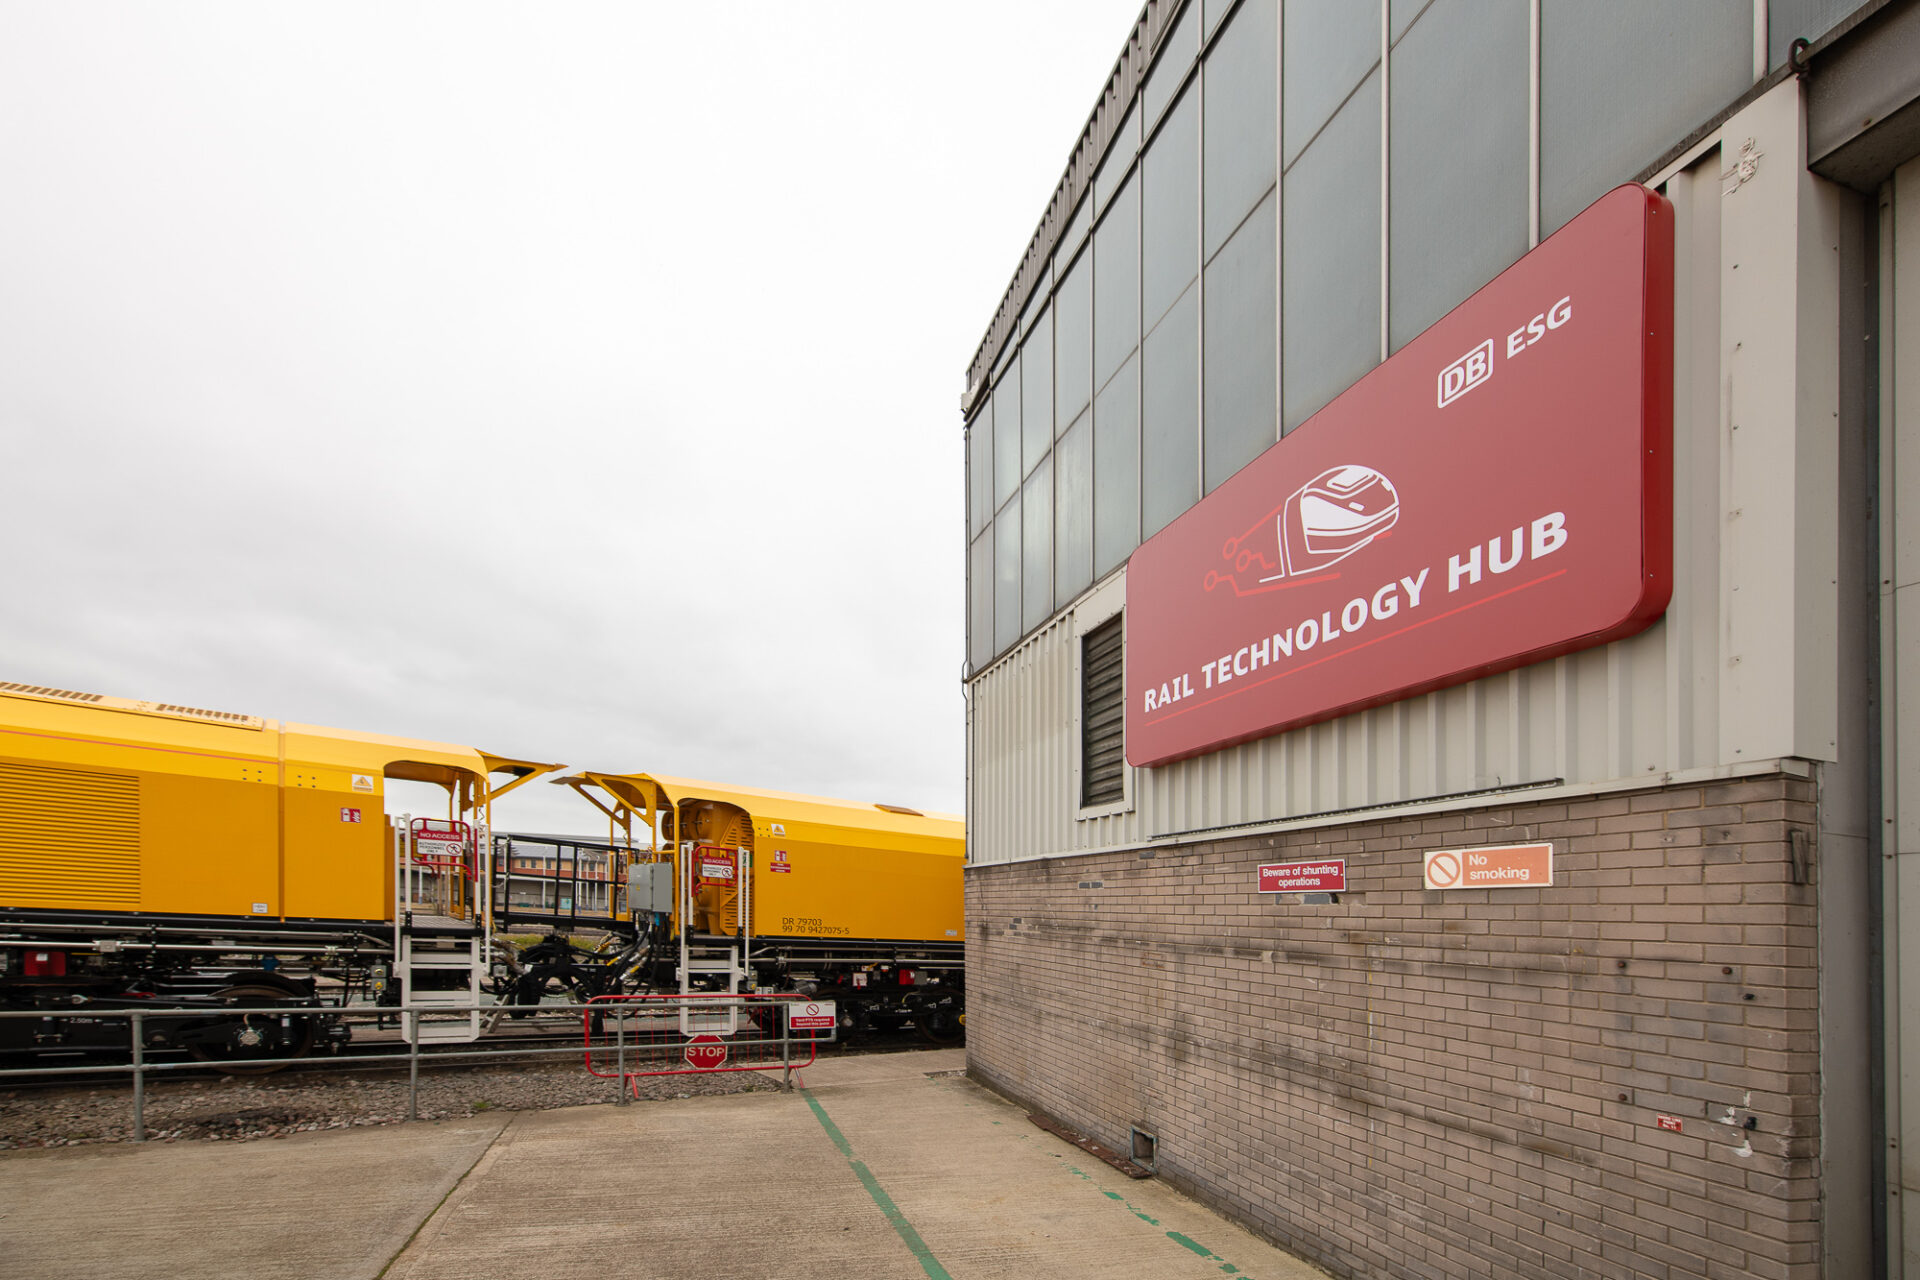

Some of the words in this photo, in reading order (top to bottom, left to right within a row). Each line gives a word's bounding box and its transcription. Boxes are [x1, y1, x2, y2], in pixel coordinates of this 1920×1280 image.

[1444, 351, 1487, 400] DB
[1507, 296, 1572, 359] ESG
[1144, 674, 1194, 713] RAIL
[1201, 567, 1430, 689] TECHNOLOGY
[1448, 511, 1568, 593] HUB
[431, 833, 461, 841] ACCESS
[1469, 854, 1488, 866] No
[1262, 868, 1291, 877] Beware
[1292, 866, 1301, 875] of
[1302, 864, 1339, 877] shunting
[1469, 867, 1530, 881] smoking
[1278, 877, 1321, 889] operations
[782, 917, 795, 926] DR
[797, 917, 823, 927] 79703
[782, 925, 793, 933] 99
[796, 925, 806, 934] 70
[687, 1046, 725, 1057] STOP
